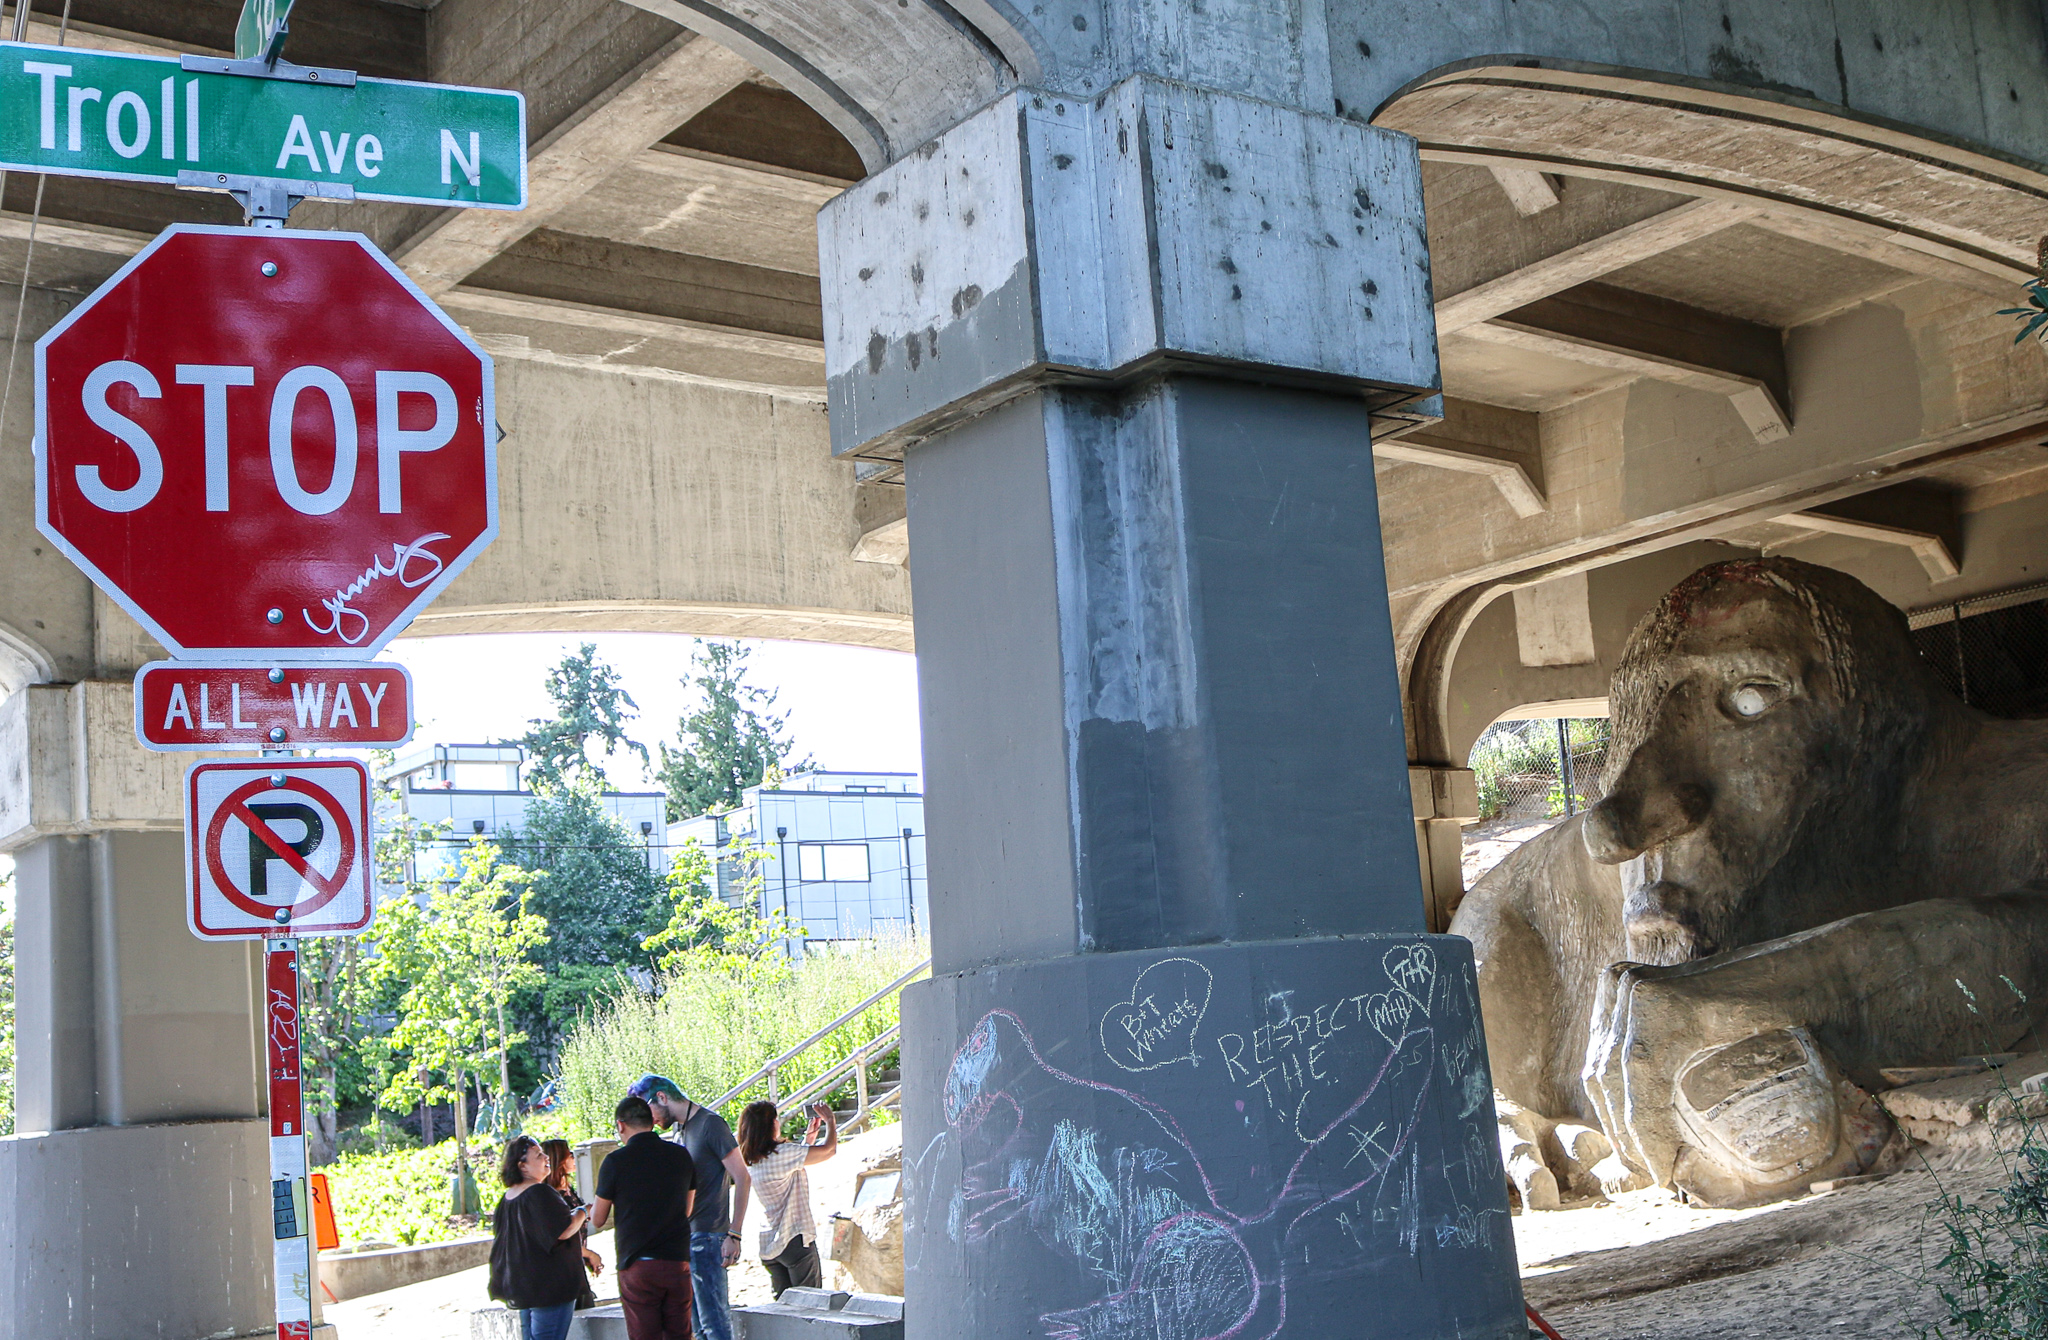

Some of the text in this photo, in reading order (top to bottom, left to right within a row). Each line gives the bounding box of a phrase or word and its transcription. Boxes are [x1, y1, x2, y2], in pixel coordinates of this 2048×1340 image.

[23, 60, 481, 187] Troll Ave N
[74, 359, 459, 516] STOP
[163, 682, 388, 731] ALL WAY
[248, 803, 324, 896] P
[1217, 993, 1369, 1083] RESPECT
[1246, 1040, 1328, 1109] THE
